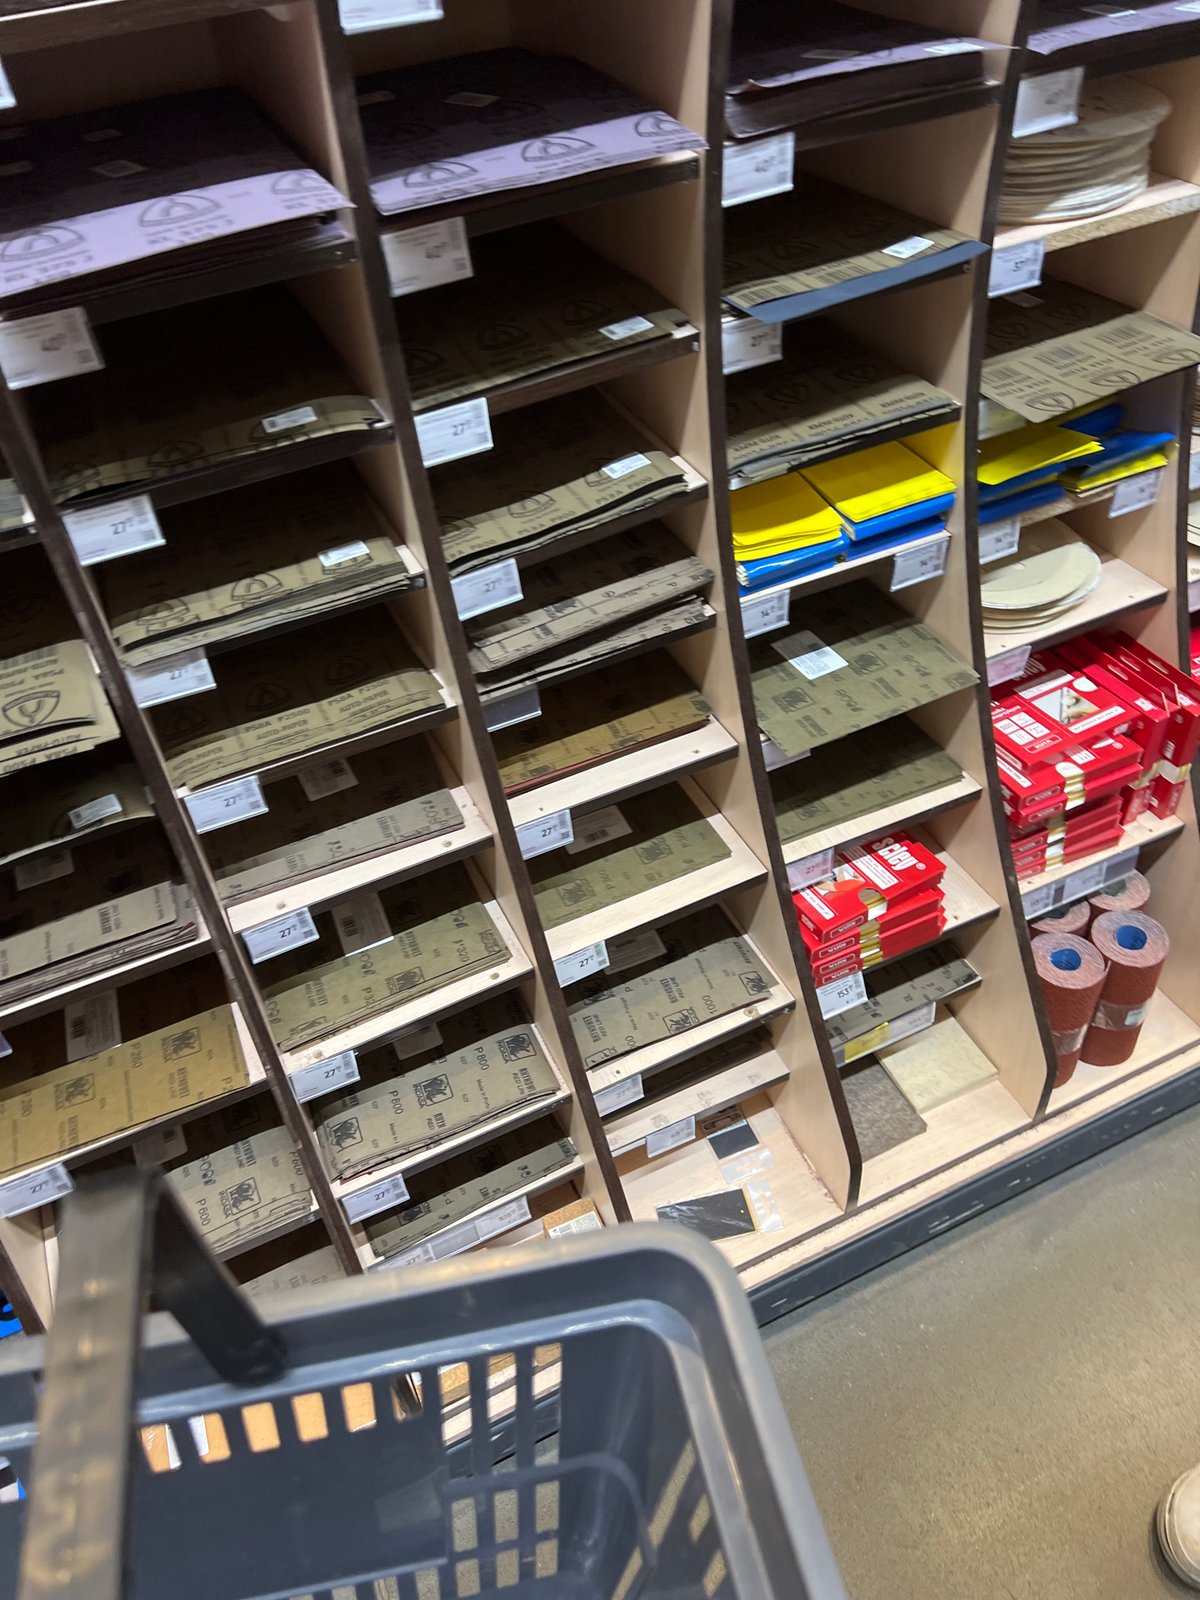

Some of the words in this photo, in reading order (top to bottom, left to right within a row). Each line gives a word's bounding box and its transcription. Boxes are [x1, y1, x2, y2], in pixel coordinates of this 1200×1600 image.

[452, 422, 466, 436] 27
[485, 581, 497, 593] 27
[761, 610, 770, 618] 14
[339, 690, 389, 713] AUTO-PAPER
[256, 719, 309, 741] AUTO-PAPER
[224, 797, 236, 808] 27
[542, 827, 552, 837] 27
[280, 927, 291, 939] 27
[579, 958, 589, 968] 27
[837, 988, 850, 999] 153
[593, 1012, 603, 1026] LINE
[597, 1024, 608, 1039] RED
[496, 1040, 509, 1064] INDASA
[474, 1047, 489, 1070] P800
[324, 1068, 336, 1079] 27
[412, 1084, 425, 1108] INDASA
[388, 1090, 403, 1115] P800
[427, 1118, 435, 1130] RED
[31, 1183, 43, 1194] 27
[374, 1190, 385, 1201] 27
[196, 1199, 211, 1226] P600
